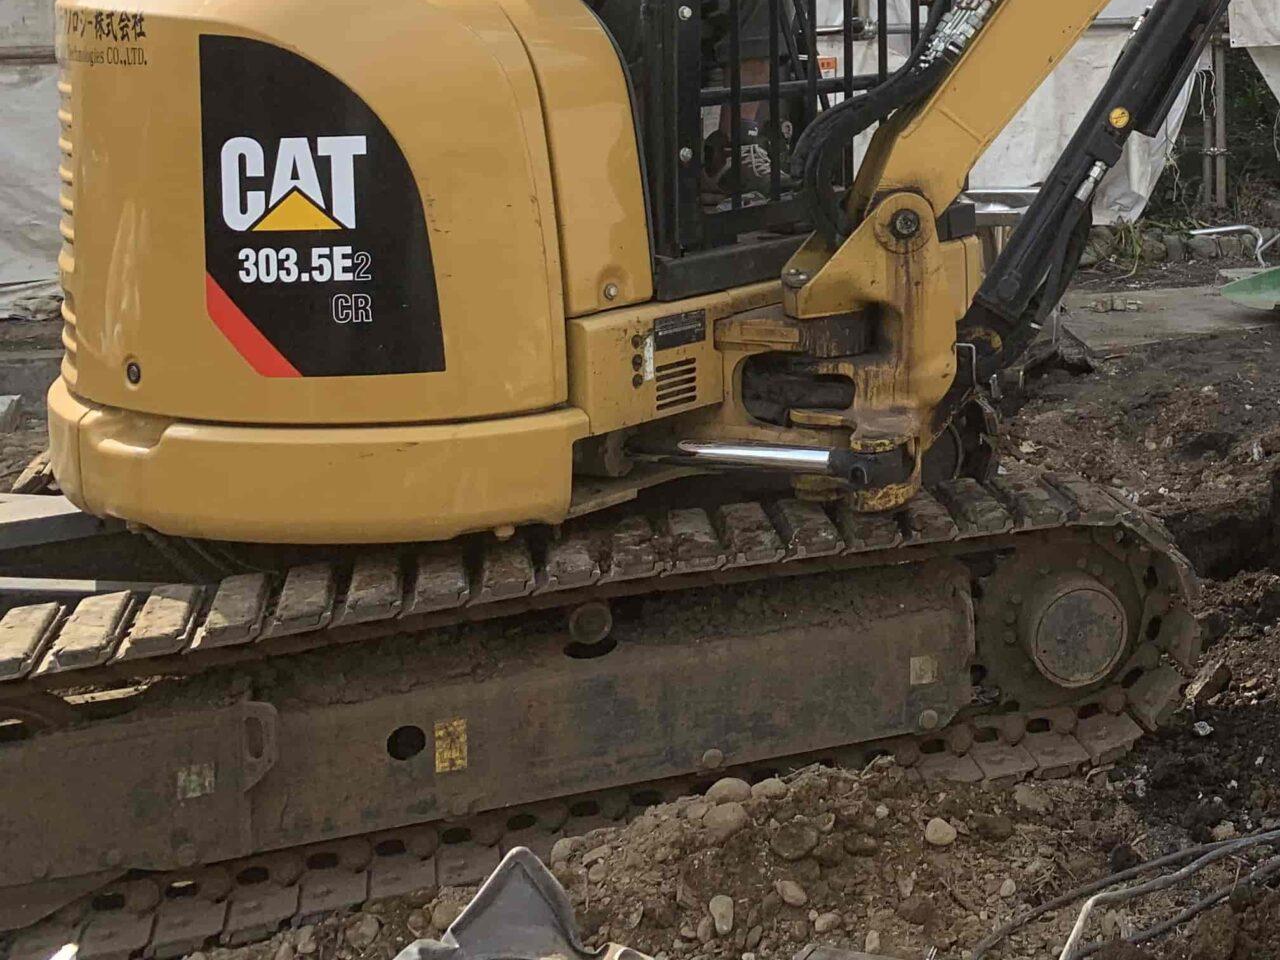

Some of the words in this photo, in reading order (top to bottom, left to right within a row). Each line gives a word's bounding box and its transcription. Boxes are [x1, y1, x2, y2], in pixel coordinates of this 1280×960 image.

[106, 46, 148, 66] CO.,LTD.
[220, 135, 367, 232] CAT
[238, 246, 372, 283] 303.5E2
[332, 293, 373, 323] CR
